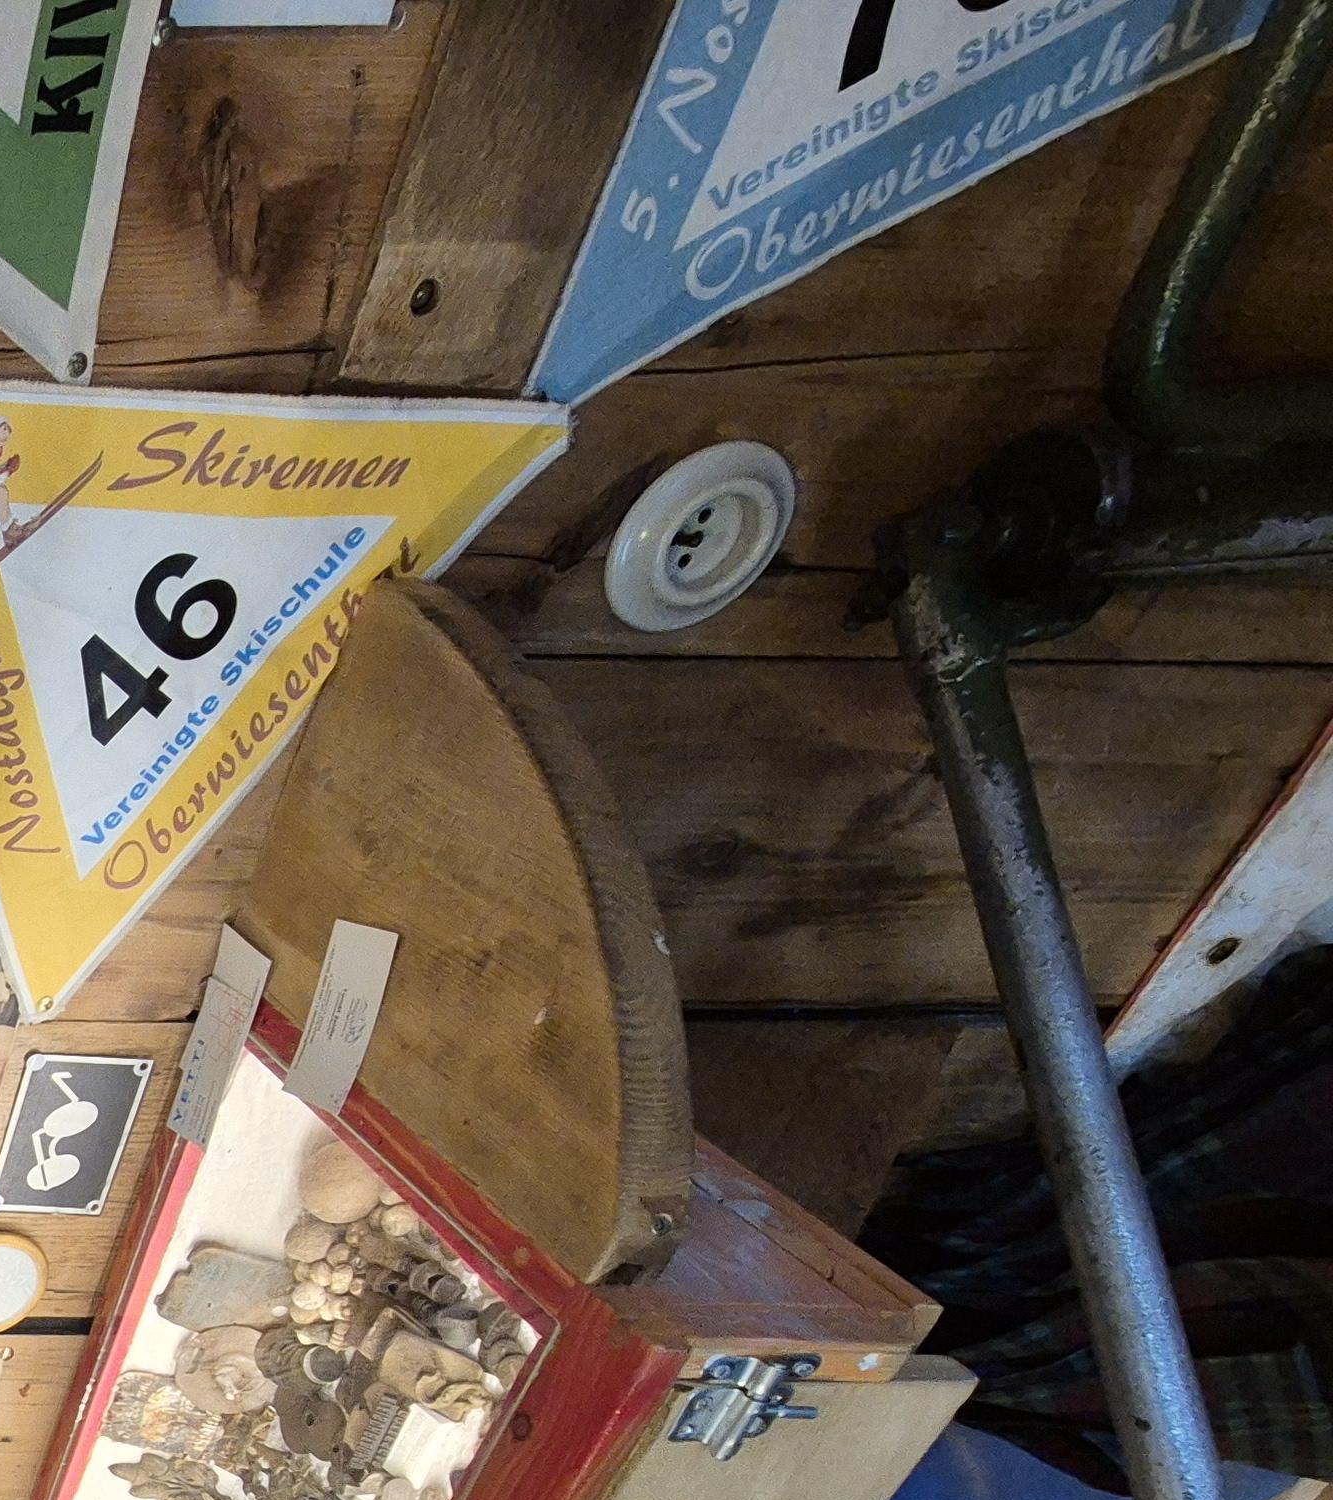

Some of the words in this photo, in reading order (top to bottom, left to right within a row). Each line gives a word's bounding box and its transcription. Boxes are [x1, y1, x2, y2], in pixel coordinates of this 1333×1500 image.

[620, 173, 681, 242] 5.
[684, 0, 1210, 301] Oberwiesenthal
[706, 69, 941, 212] Vereinigte
[106, 421, 412, 491] Skirennen
[80, 552, 238, 747] 46
[80, 694, 221, 847] Vereinigte
[218, 525, 368, 687] Skischule
